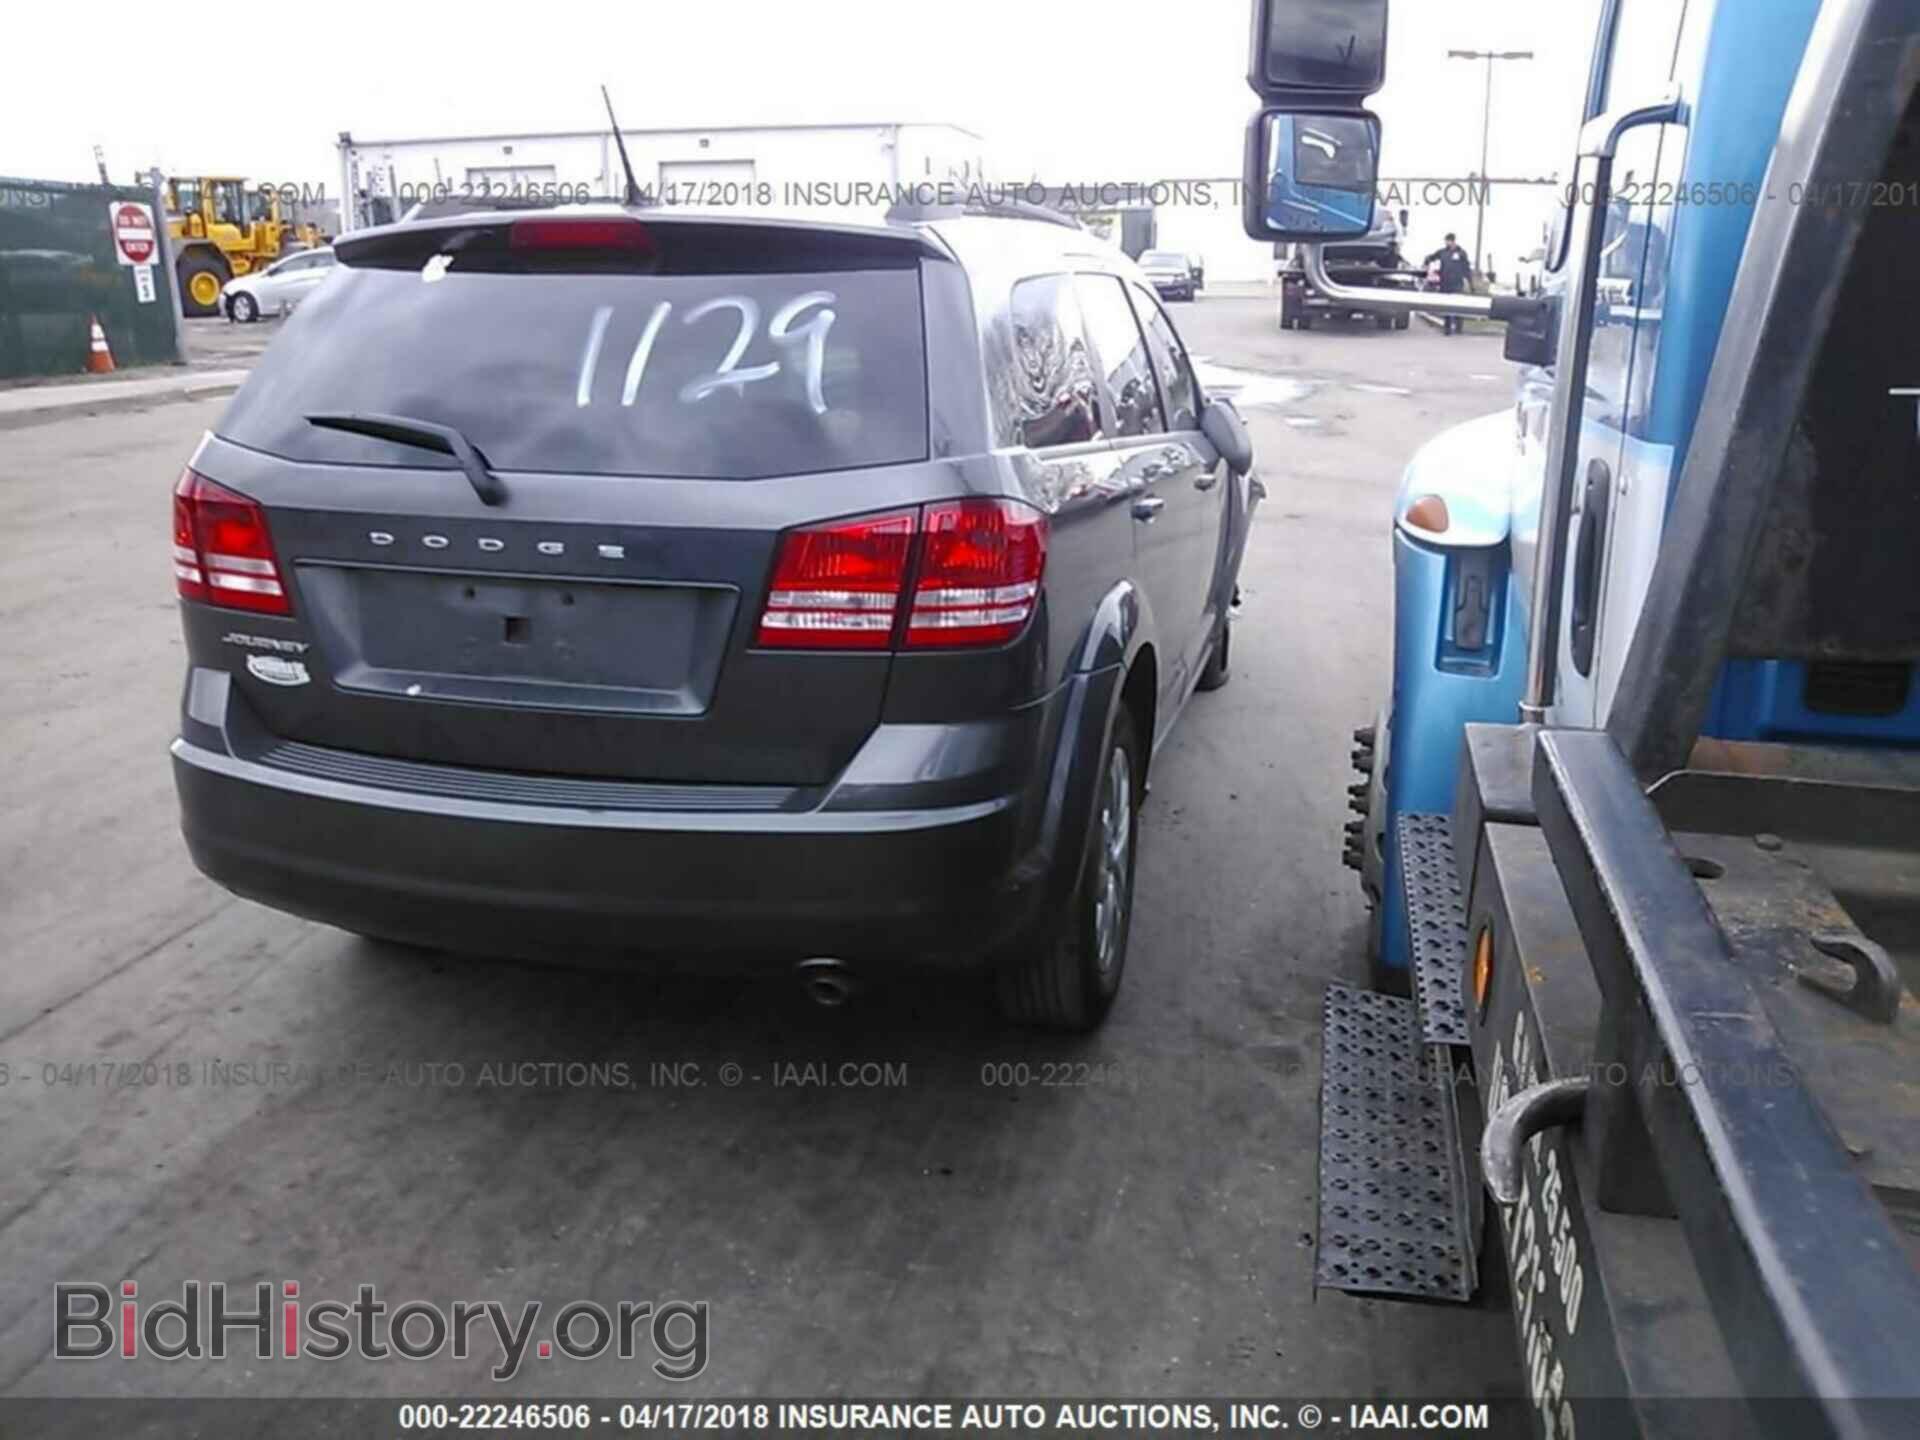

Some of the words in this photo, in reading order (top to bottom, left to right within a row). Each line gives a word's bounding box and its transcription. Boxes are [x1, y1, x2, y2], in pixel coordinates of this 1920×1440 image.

[576, 290, 837, 415] 1129
[369, 530, 625, 559] DODGE
[221, 632, 311, 653] JOURNEY
